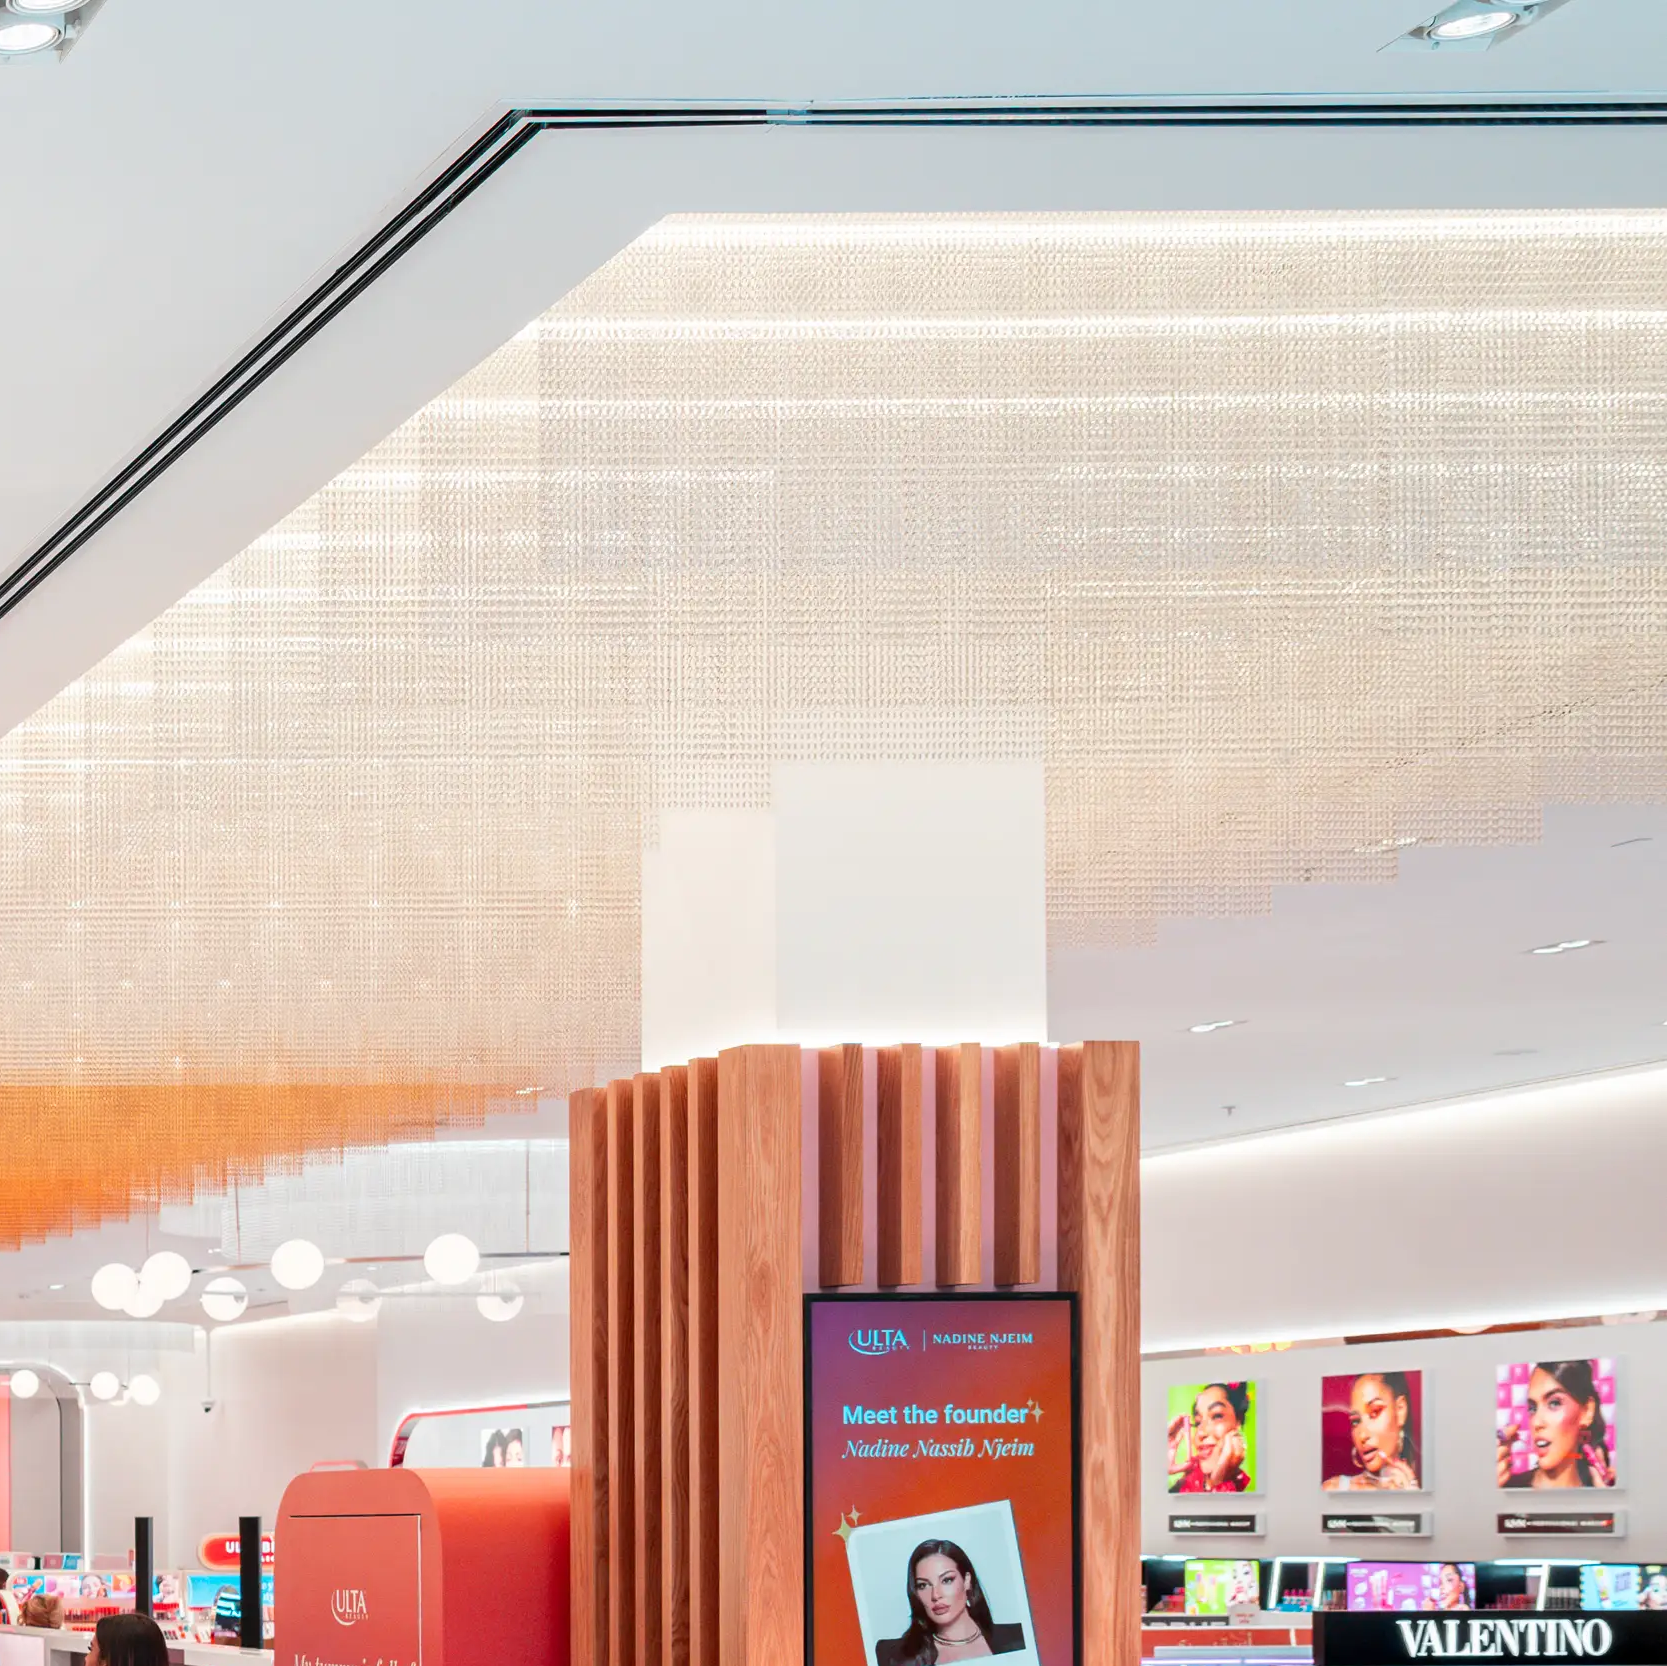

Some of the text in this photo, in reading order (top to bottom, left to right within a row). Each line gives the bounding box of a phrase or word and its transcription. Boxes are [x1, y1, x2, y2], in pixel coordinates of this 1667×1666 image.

[857, 1329, 908, 1346] ULTA
[932, 1332, 1034, 1344] NADINE NJEIM
[843, 1403, 1029, 1425] Meet the founder
[842, 1438, 1034, 1460] Nadine Nassib Njeim
[335, 1589, 368, 1614] ULTA
[1396, 1619, 1612, 1657] VALENTINO
